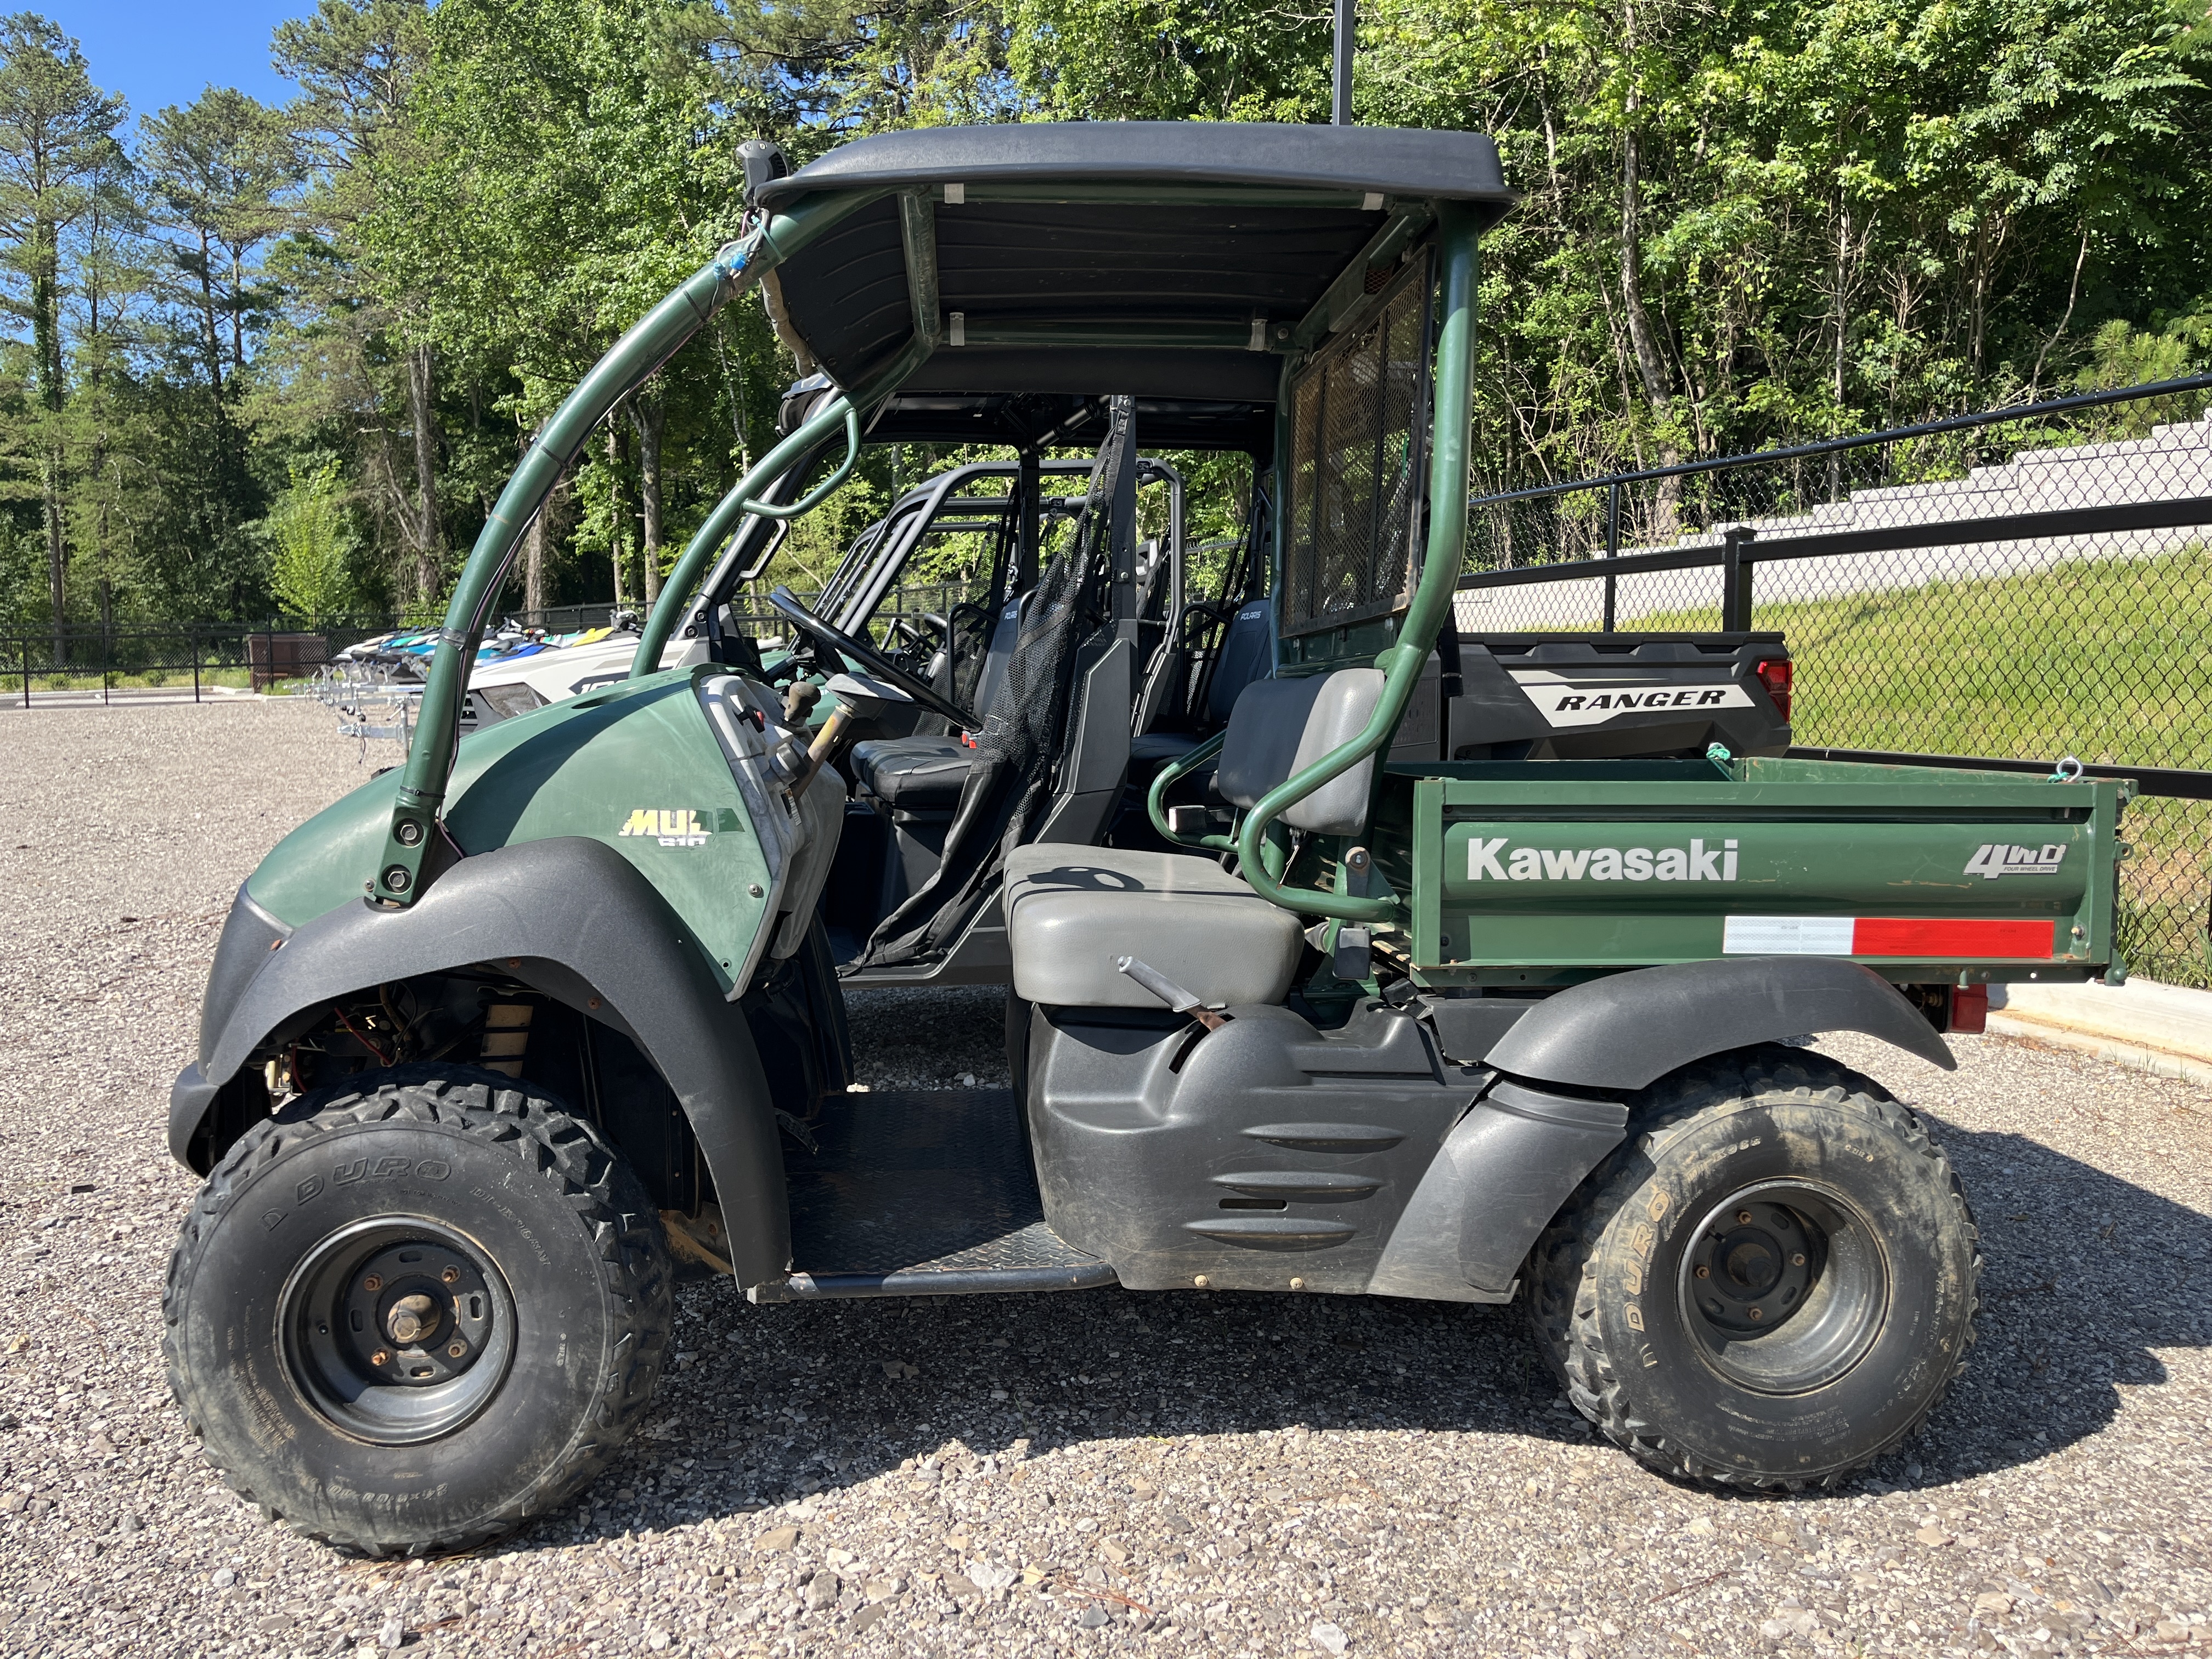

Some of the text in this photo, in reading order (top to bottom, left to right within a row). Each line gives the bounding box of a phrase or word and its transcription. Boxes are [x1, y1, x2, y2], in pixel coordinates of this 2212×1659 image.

[1240, 611, 1261, 620] POLARIS
[1555, 690, 1726, 711] RANGER
[1468, 838, 1738, 881] Kawasaki
[1963, 844, 2067, 879] 4WD
[295, 1155, 452, 1206] DURO
[1622, 1190, 1671, 1333] DURO
